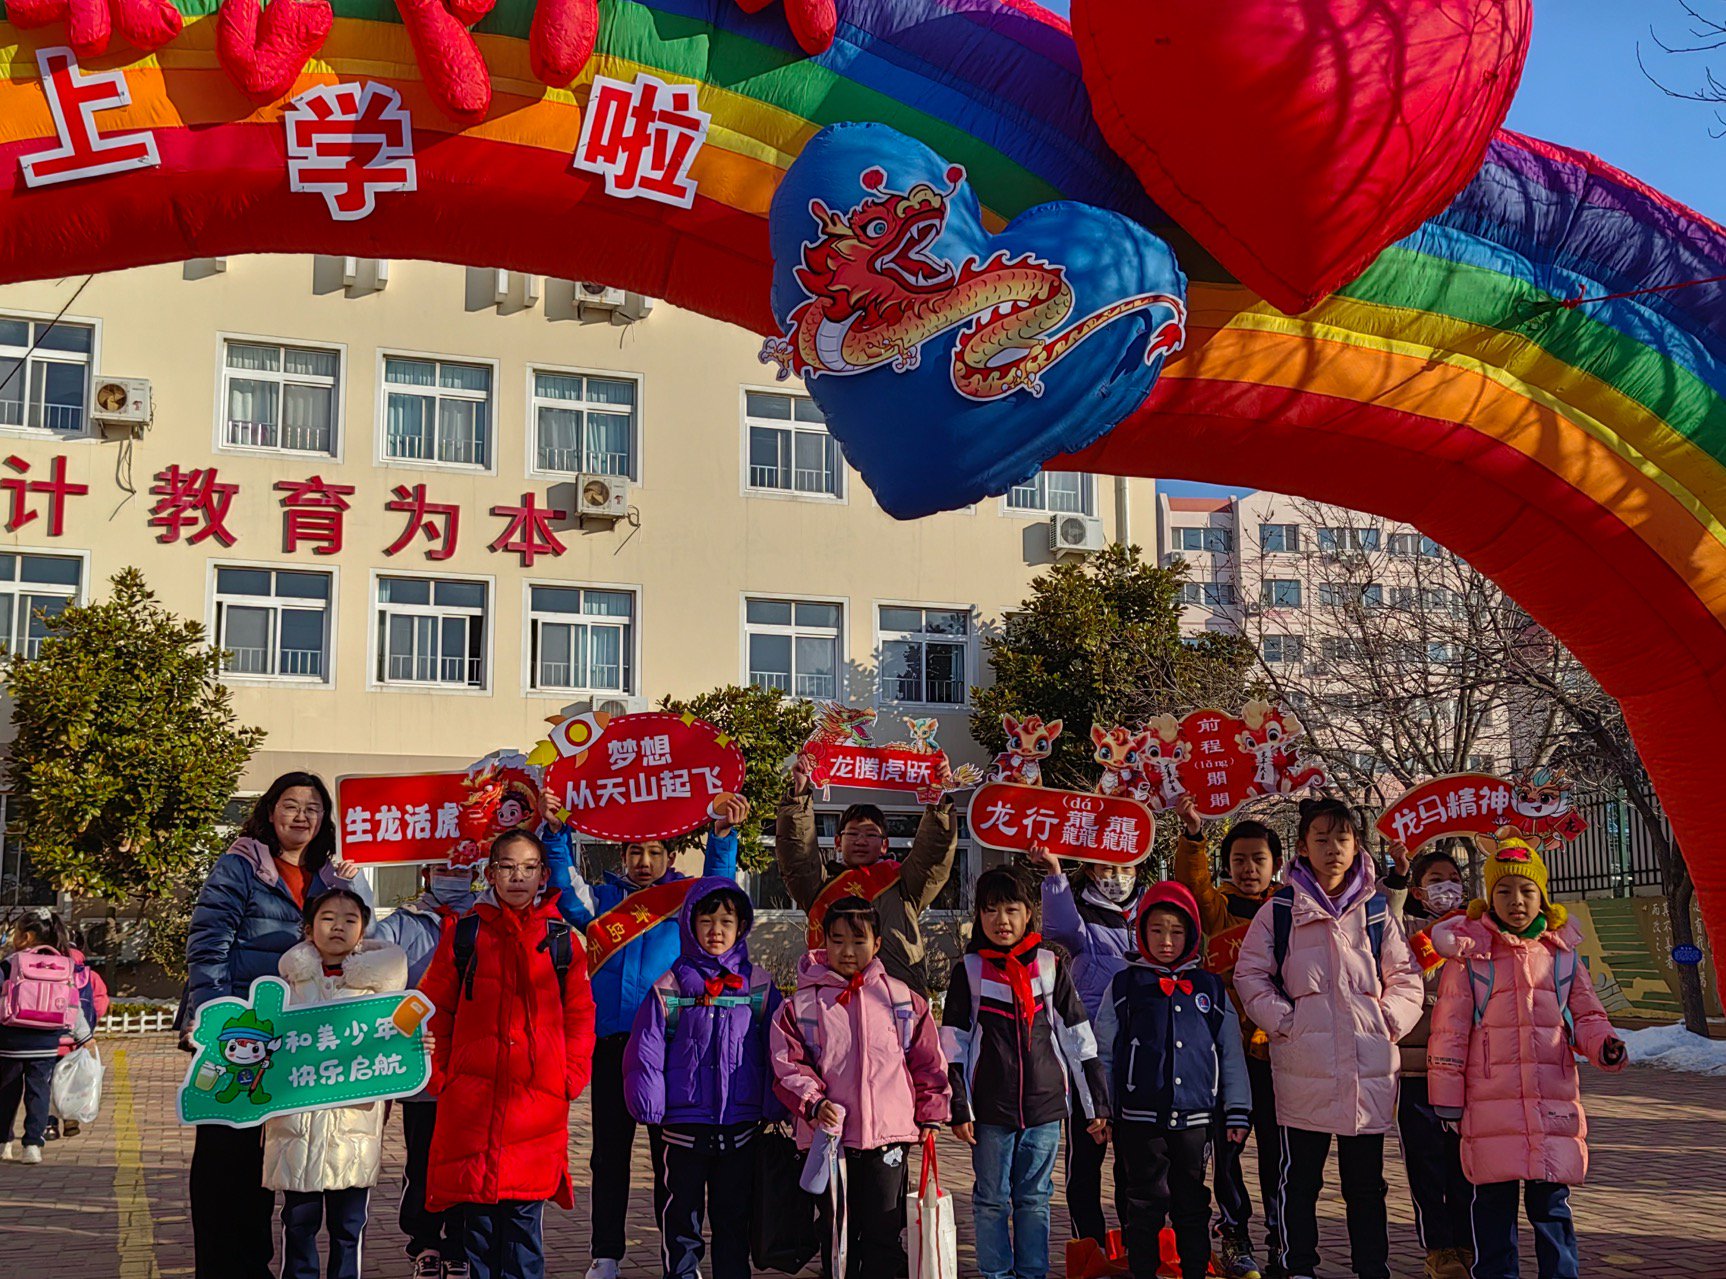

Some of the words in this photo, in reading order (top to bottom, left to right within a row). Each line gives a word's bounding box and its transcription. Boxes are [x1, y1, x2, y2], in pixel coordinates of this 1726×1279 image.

[20, 47, 709, 220] 上学啦
[0, 455, 89, 537] 计
[149, 464, 568, 567] 教育为本
[608, 734, 672, 771] 梦想
[829, 755, 931, 785] 龙腾虎跃
[565, 766, 723, 811] 从天山起飞
[345, 801, 461, 844] 生龙活虎
[1392, 785, 1510, 844] 龙马精神
[285, 1015, 399, 1054] 和美少年
[288, 1052, 407, 1088] 快乐启航
